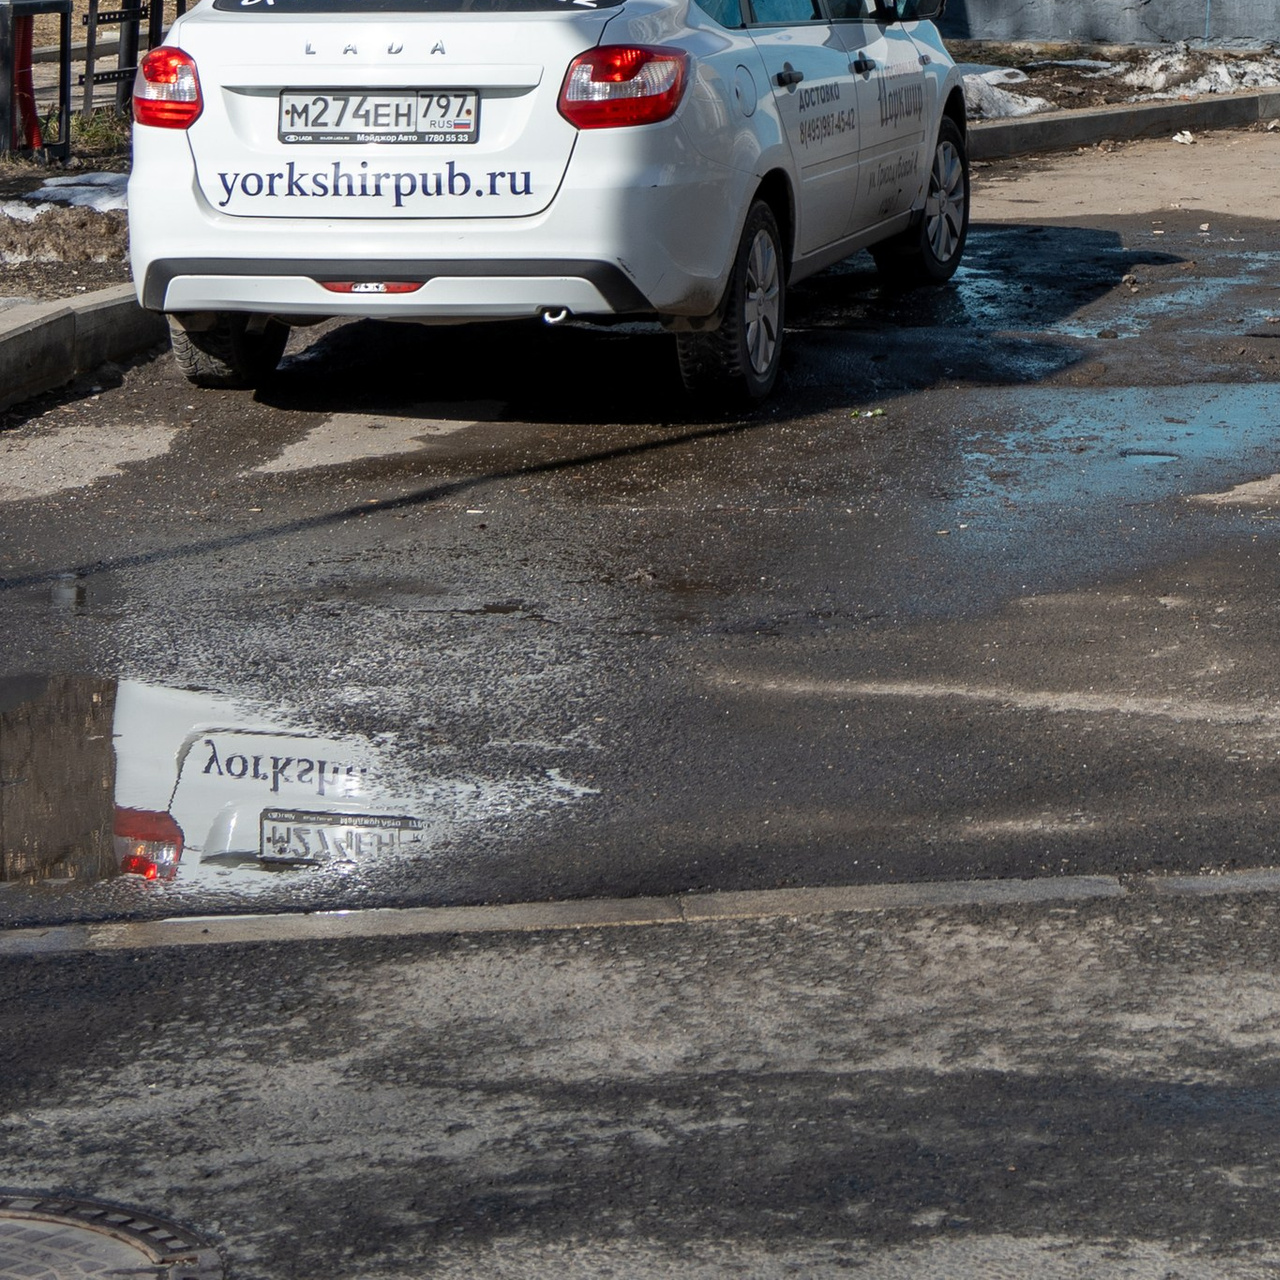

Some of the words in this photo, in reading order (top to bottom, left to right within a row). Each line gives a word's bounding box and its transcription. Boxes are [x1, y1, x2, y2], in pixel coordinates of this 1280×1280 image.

[304, 39, 447, 55] LADA
[799, 81, 840, 113] доставка
[289, 96, 413, 128] М274ЕН
[419, 94, 468, 119] 797
[429, 119, 453, 129] RUS
[799, 107, 856, 150] 8(495)987-45-42
[357, 134, 397, 144] Мэйджор
[398, 134, 418, 142] Авто
[445, 134, 457, 143] 55
[457, 134, 469, 143] 33
[217, 160, 534, 208] yorkshirpub.ru
